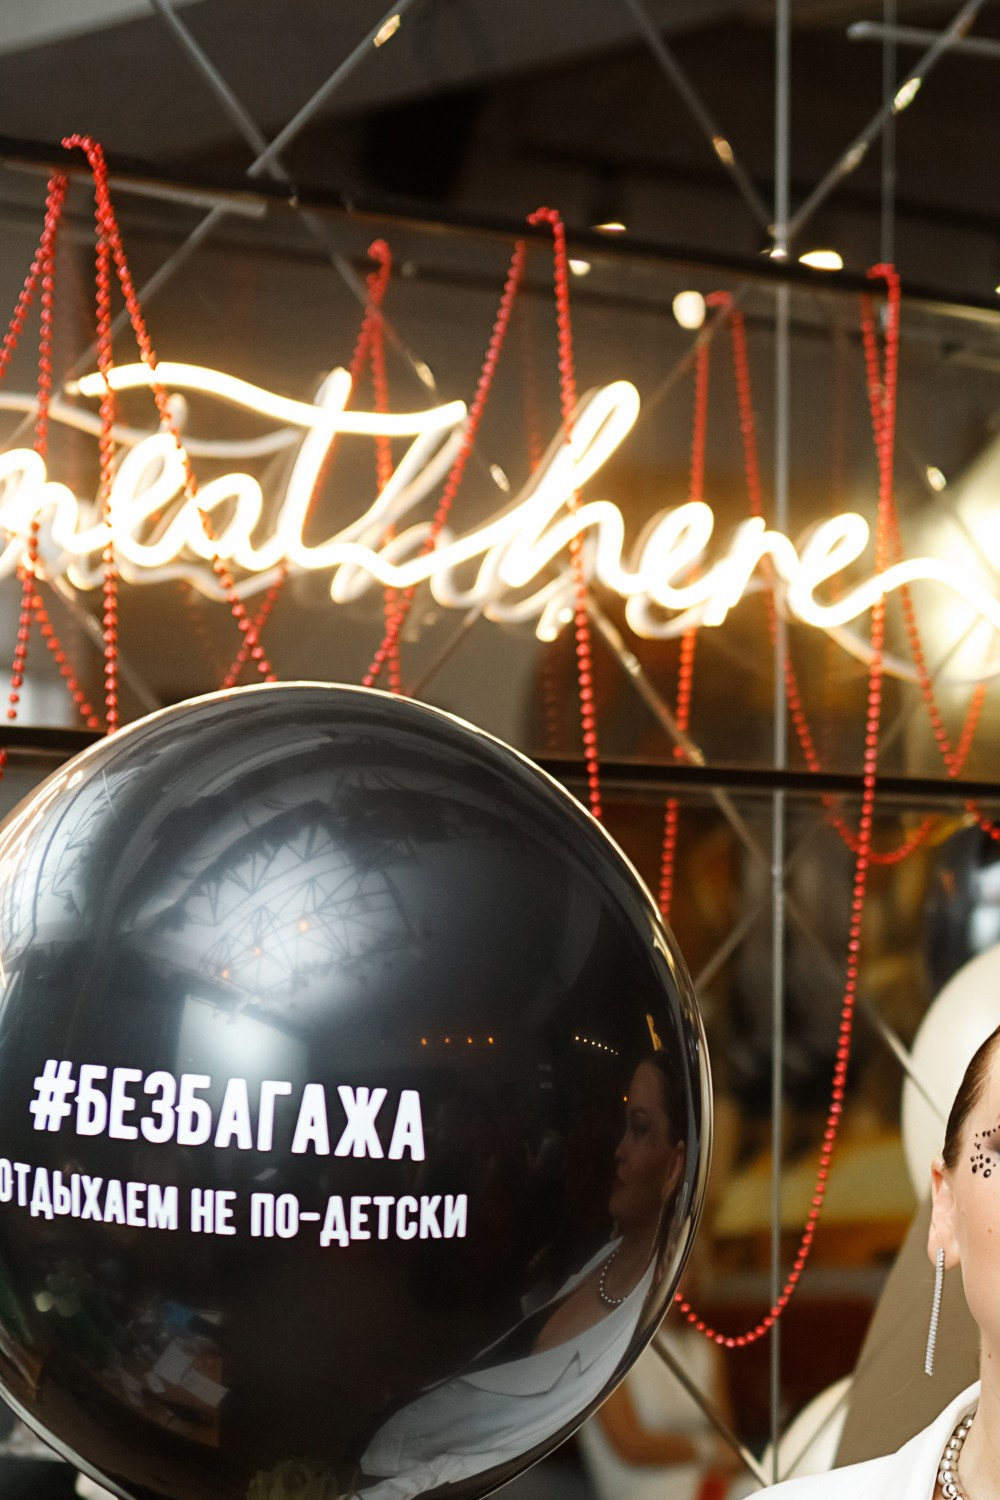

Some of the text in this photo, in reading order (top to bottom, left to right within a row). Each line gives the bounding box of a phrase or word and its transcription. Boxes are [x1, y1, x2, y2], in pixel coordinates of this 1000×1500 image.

[29, 1059, 425, 1161] #БЕЗБАГАЖА
[191, 1188, 237, 1235] НЕ
[250, 1193, 468, 1247] ПО-ДЕТСКИ
